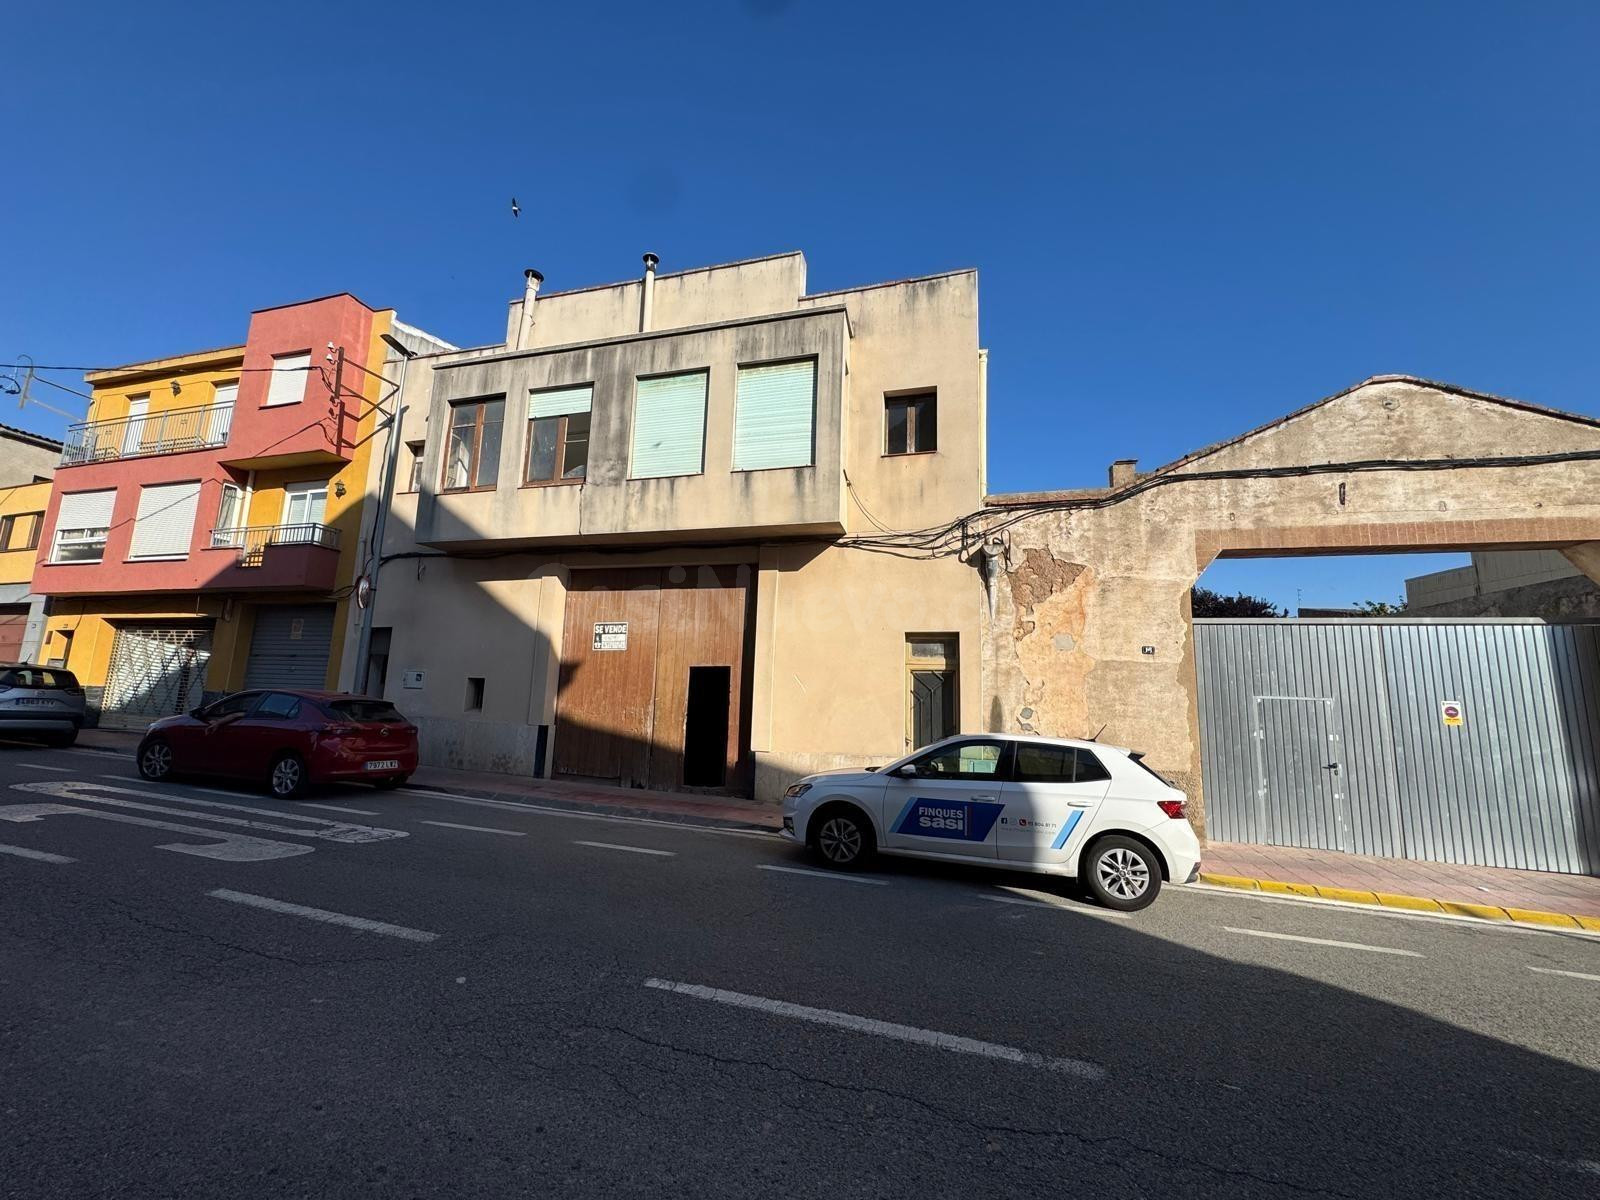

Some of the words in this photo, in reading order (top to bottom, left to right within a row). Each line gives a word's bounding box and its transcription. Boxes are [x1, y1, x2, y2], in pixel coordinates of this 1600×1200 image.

[595, 625, 604, 634] SE
[604, 624, 627, 634] VENDE
[918, 806, 964, 819] FINQUES
[919, 816, 963, 830] sasi
